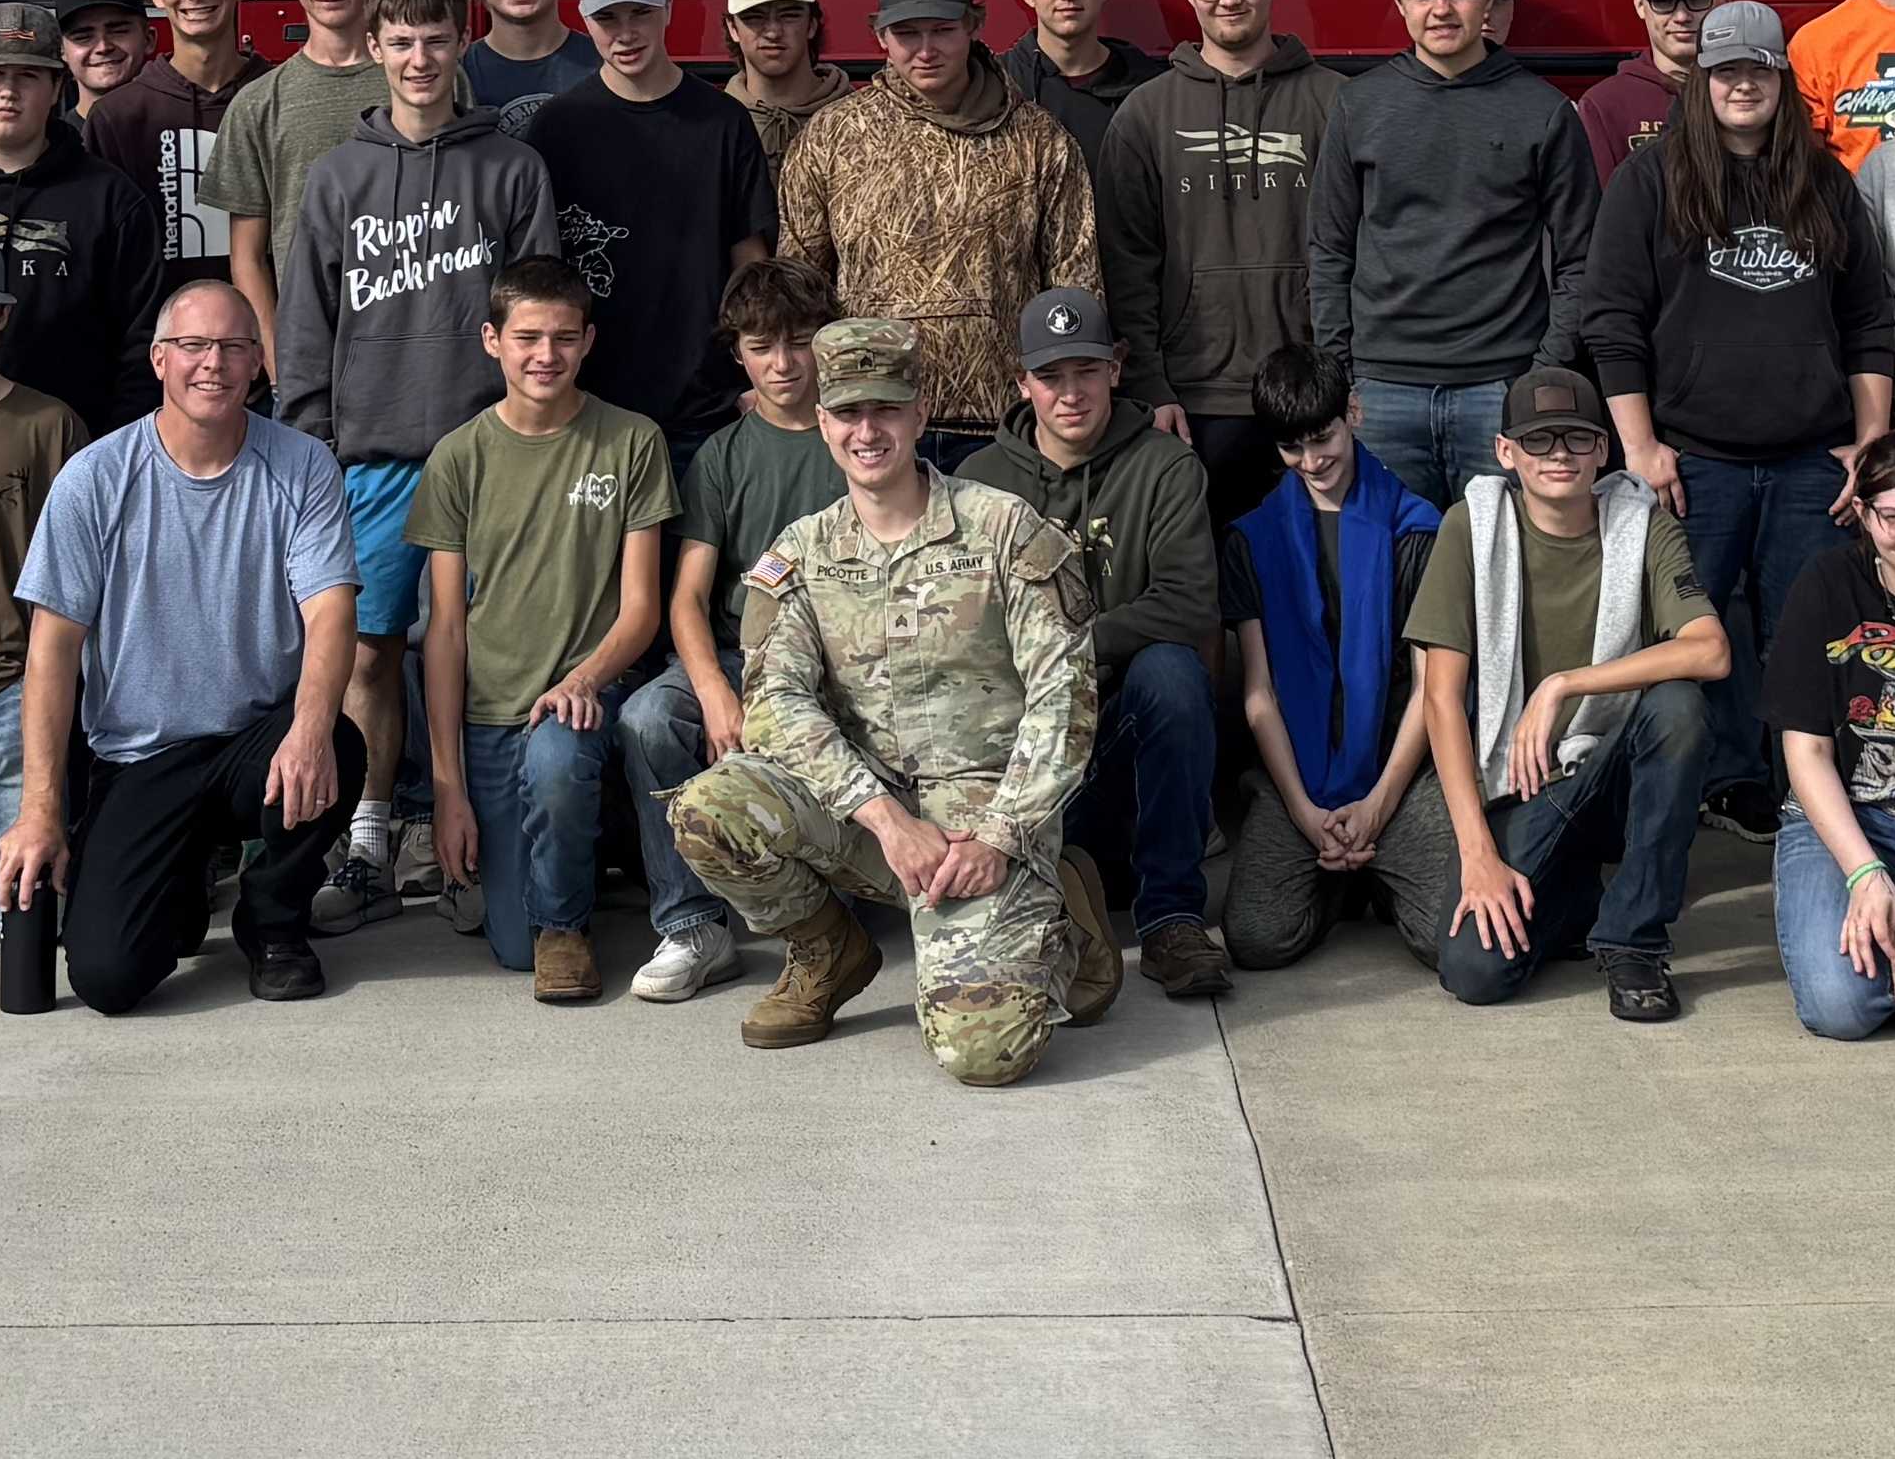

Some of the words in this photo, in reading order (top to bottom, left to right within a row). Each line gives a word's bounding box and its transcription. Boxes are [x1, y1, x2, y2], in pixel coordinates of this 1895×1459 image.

[1180, 171, 1307, 193] SITKA
[350, 199, 461, 262] Rippin
[1708, 234, 1811, 279] Hurley
[816, 564, 868, 581] PICOTTE
[950, 555, 984, 572] ARMY
